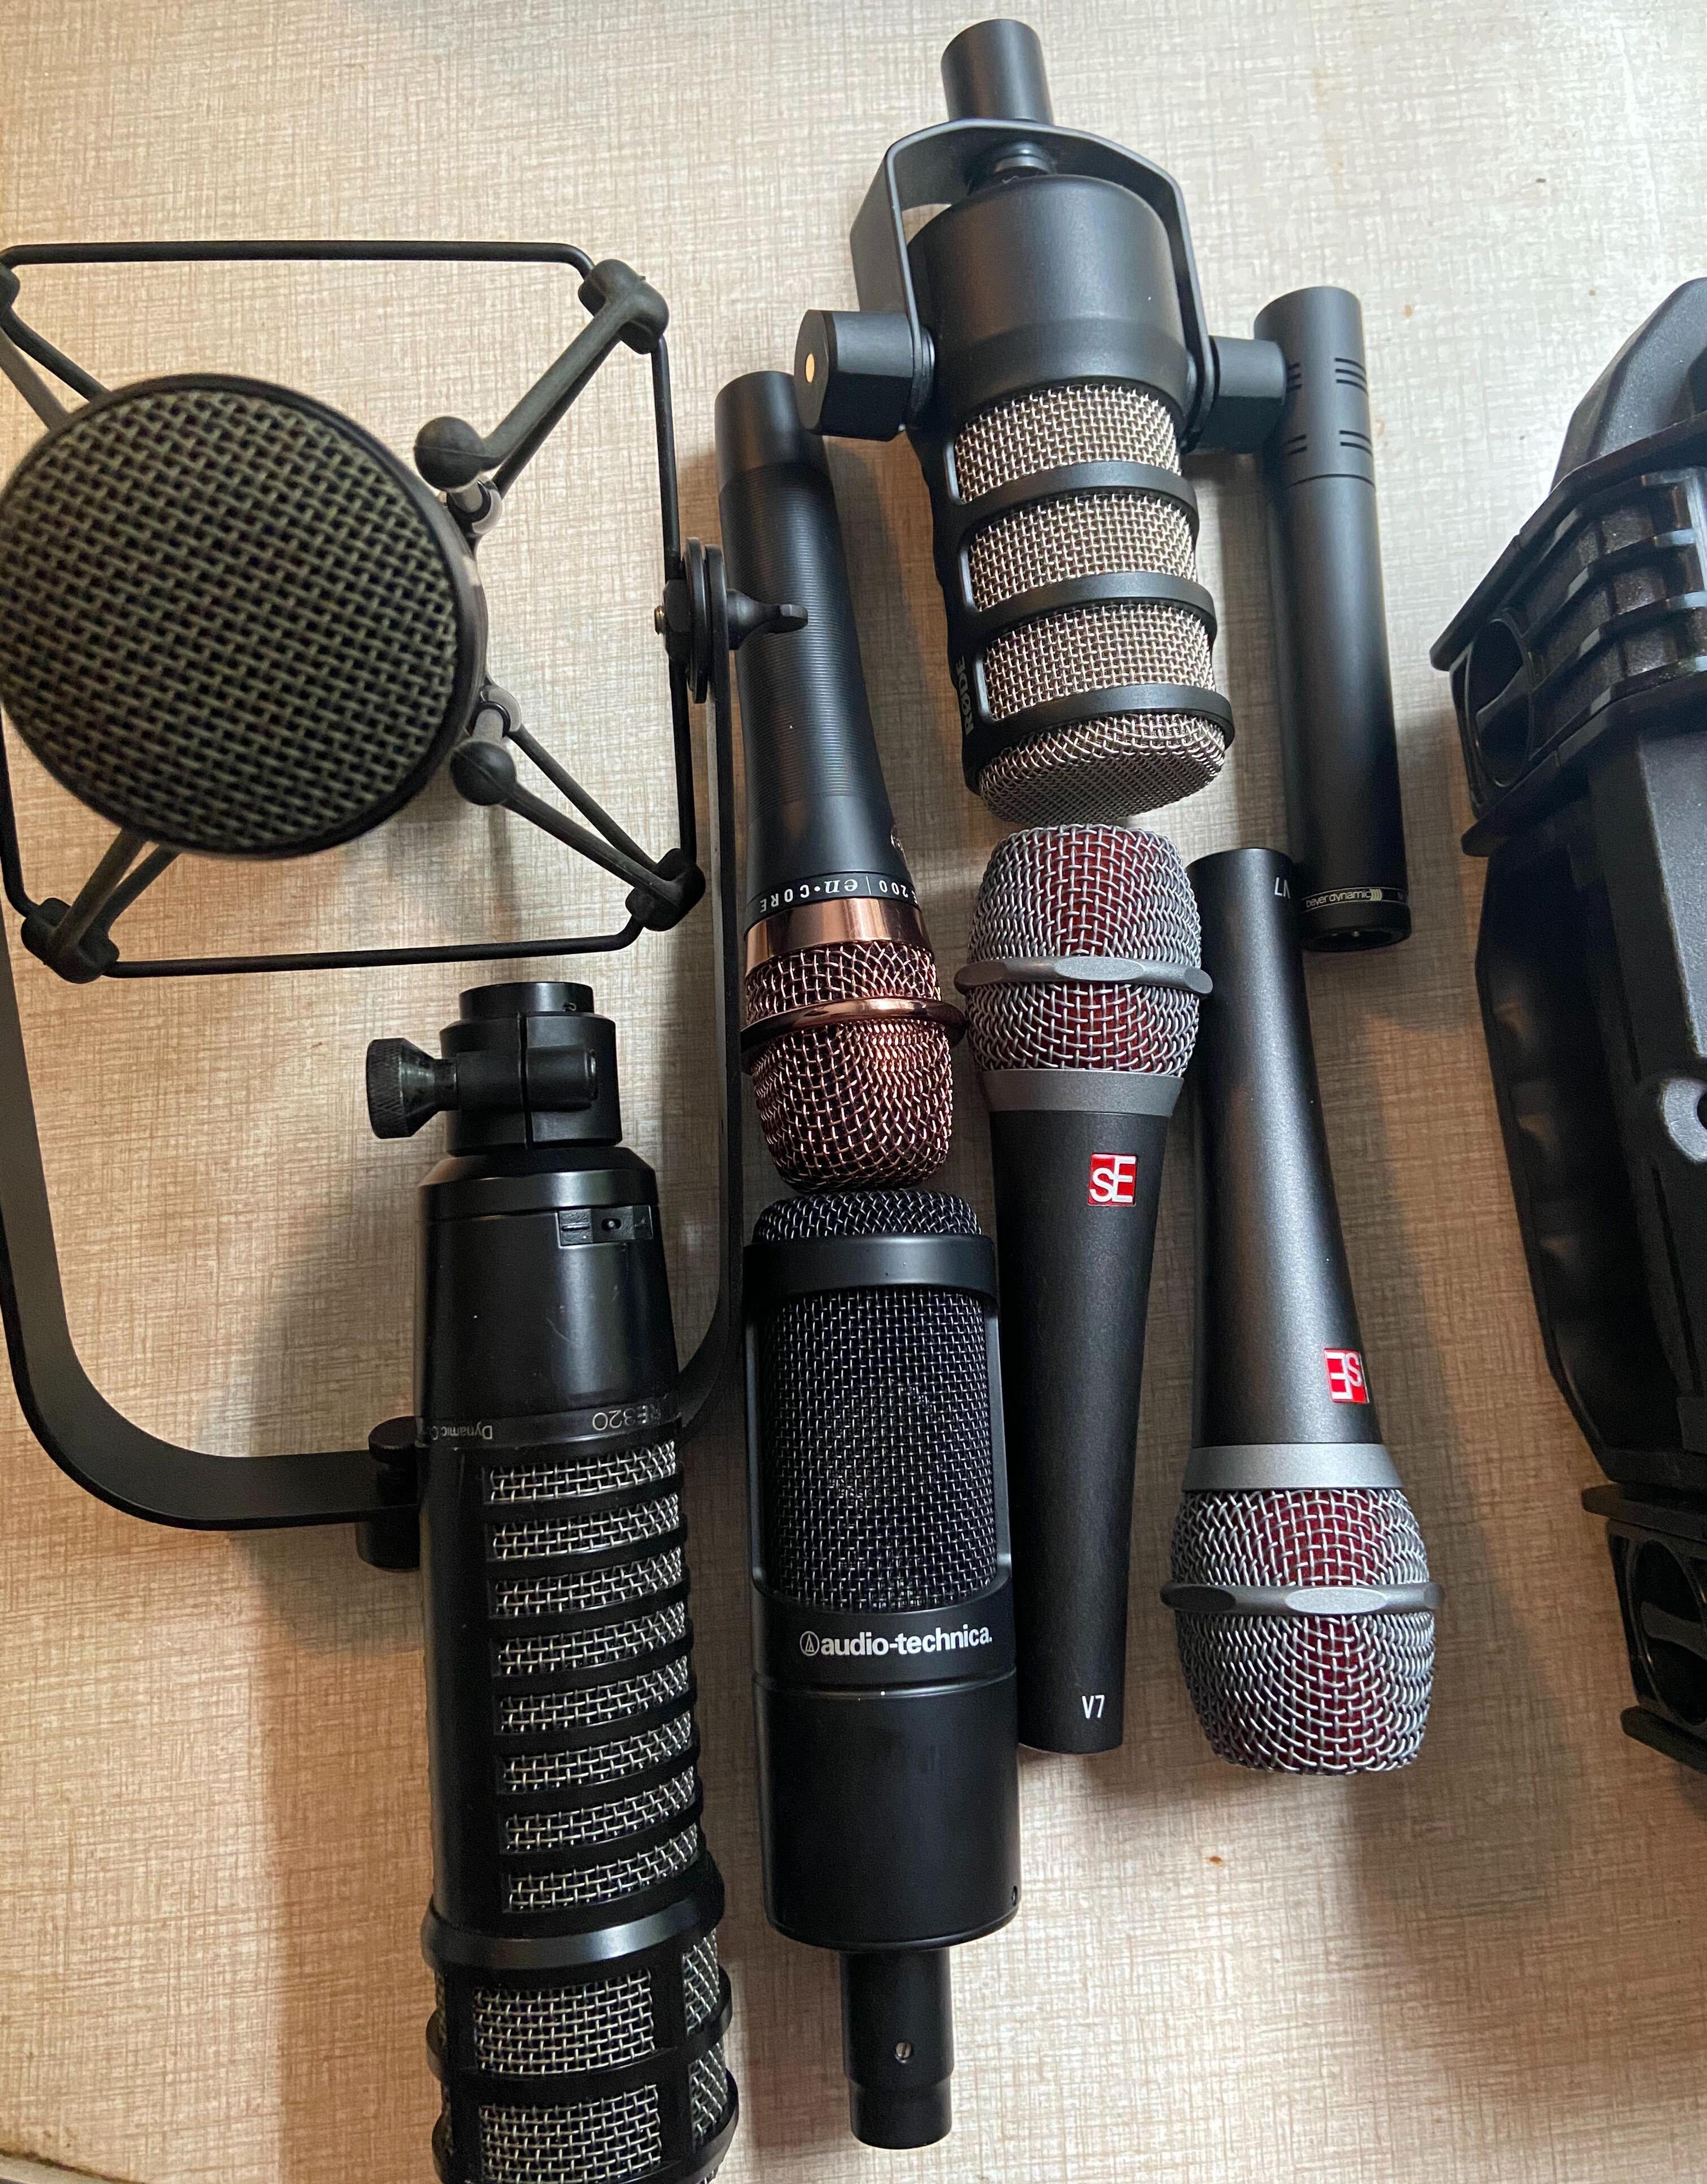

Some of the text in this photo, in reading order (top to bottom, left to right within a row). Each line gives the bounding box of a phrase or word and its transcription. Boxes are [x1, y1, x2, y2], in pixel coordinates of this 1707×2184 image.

[879, 880, 908, 898] 200
[1274, 877, 1291, 899] V7
[441, 1421, 493, 1441] Dynamic
[1082, 1694, 1105, 1719] V7
